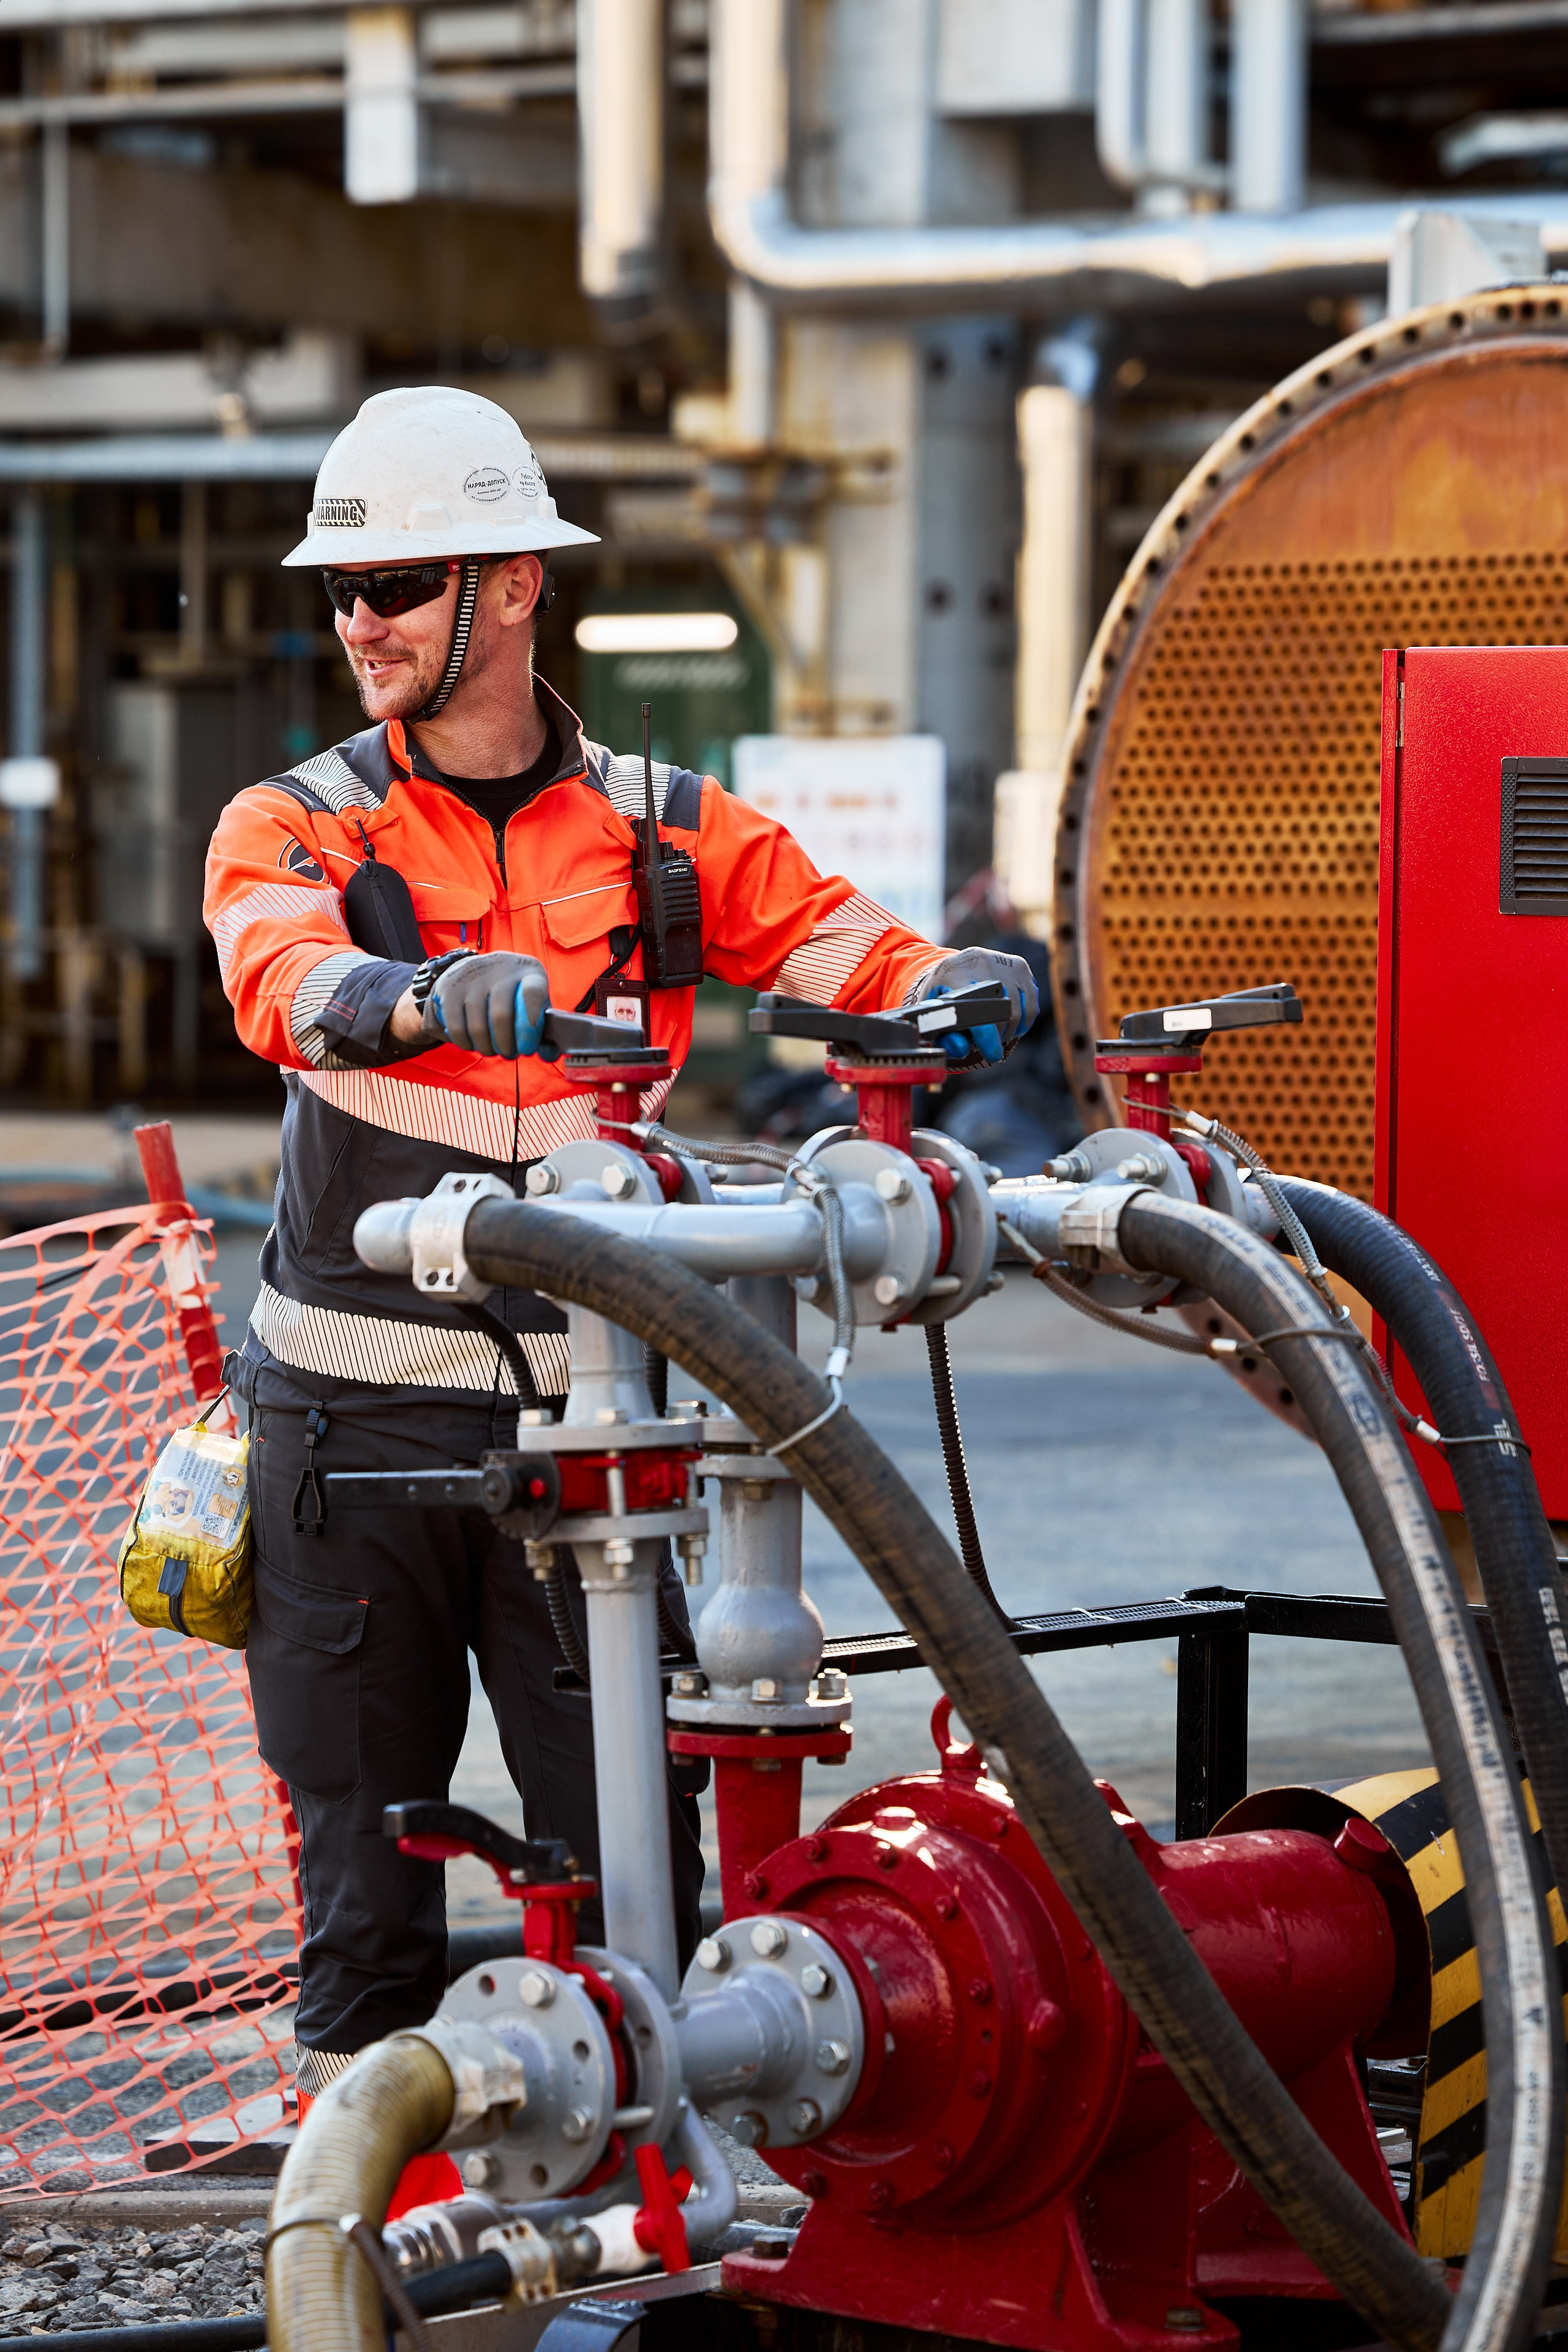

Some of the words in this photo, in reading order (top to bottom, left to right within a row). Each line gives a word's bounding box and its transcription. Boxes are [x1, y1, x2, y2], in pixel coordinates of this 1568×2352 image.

[467, 478, 506, 489] НАРЯД-ДОПУСК
[316, 506, 358, 521] WARNING
[1493, 1418, 1518, 1457] SEL
